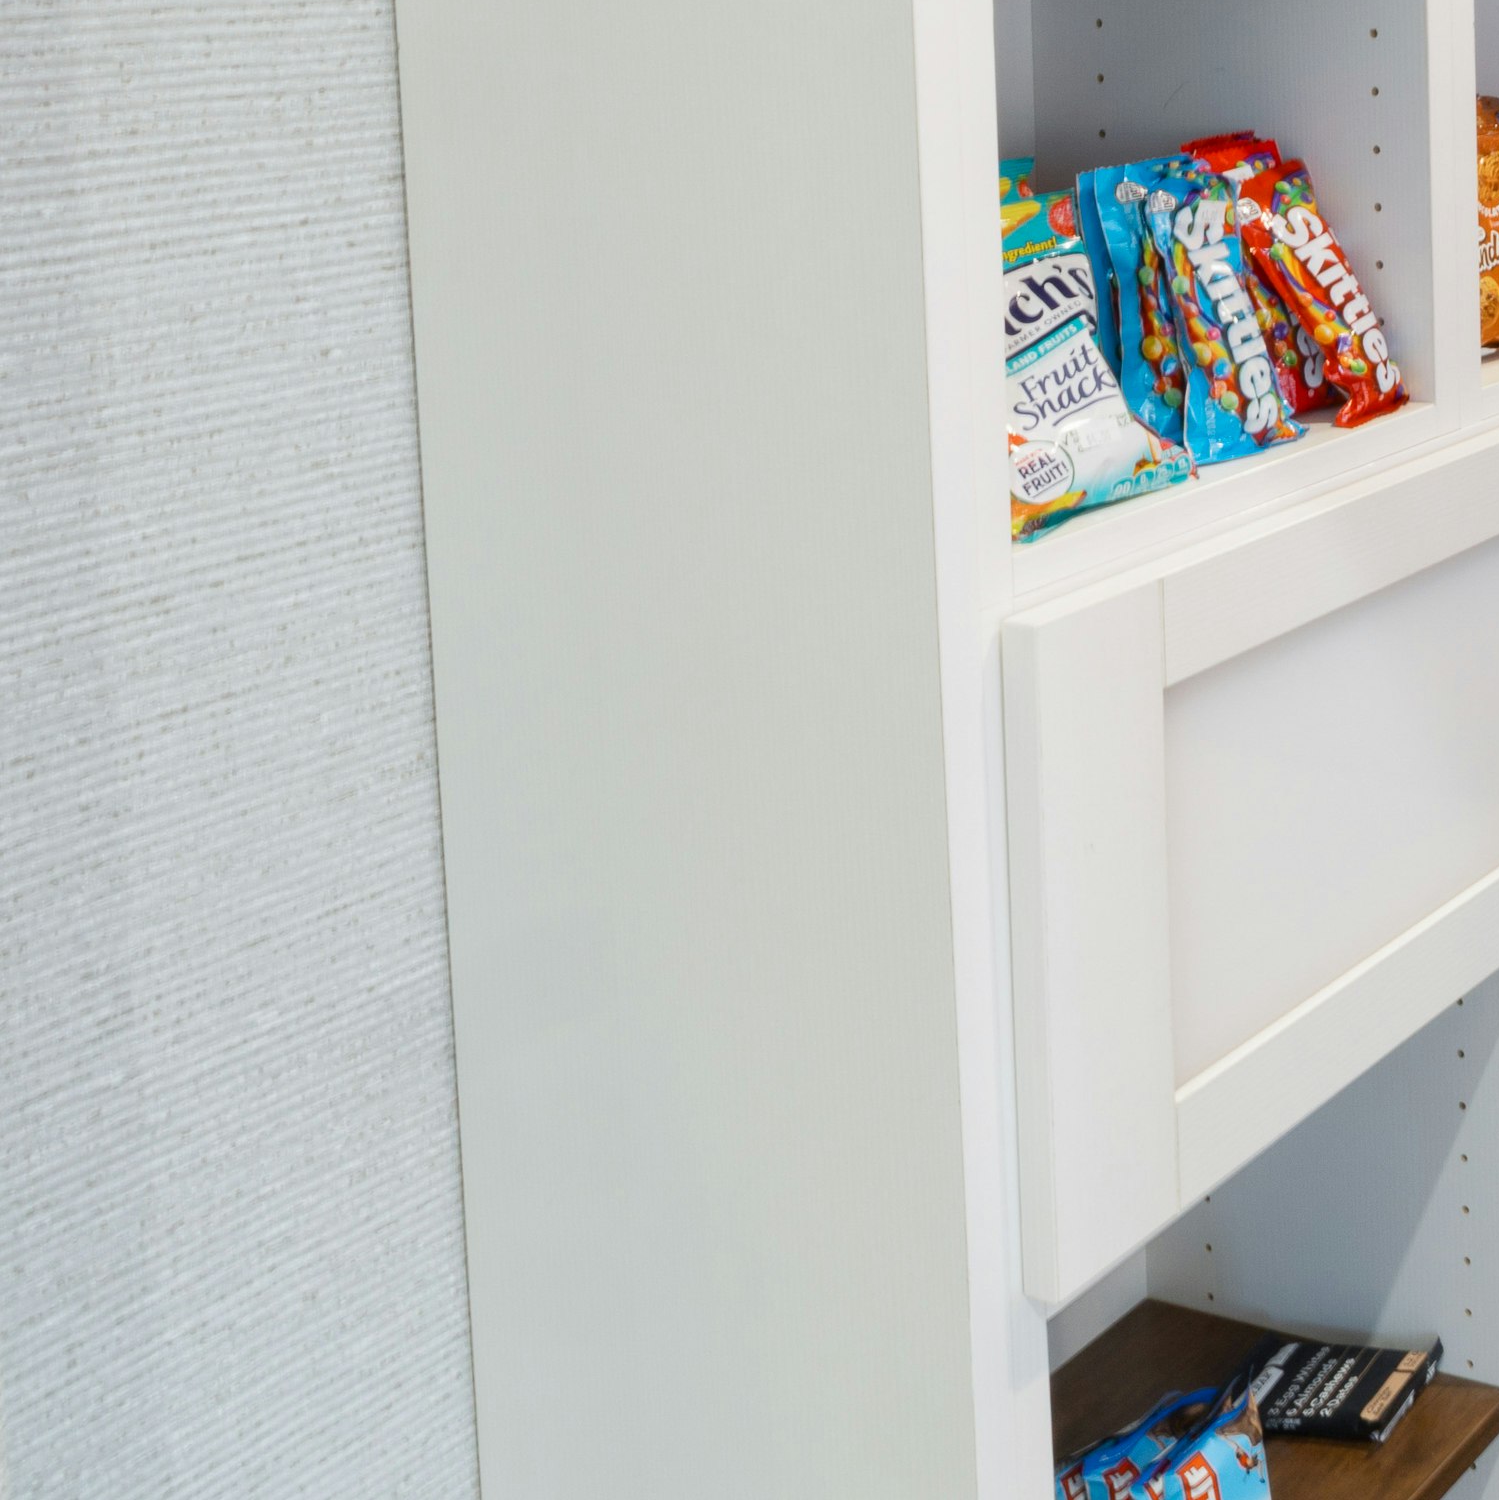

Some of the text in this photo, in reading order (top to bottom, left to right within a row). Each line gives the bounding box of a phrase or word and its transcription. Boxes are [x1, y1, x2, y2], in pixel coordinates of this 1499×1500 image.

[1038, 323, 1079, 357] FRUITS
[1018, 342, 1100, 403] Fruit
[1017, 450, 1057, 481] REAL
[1294, 1358, 1339, 1408] Almonds
[1310, 1357, 1356, 1408] Cashews
[1326, 1374, 1360, 1408] Dates
